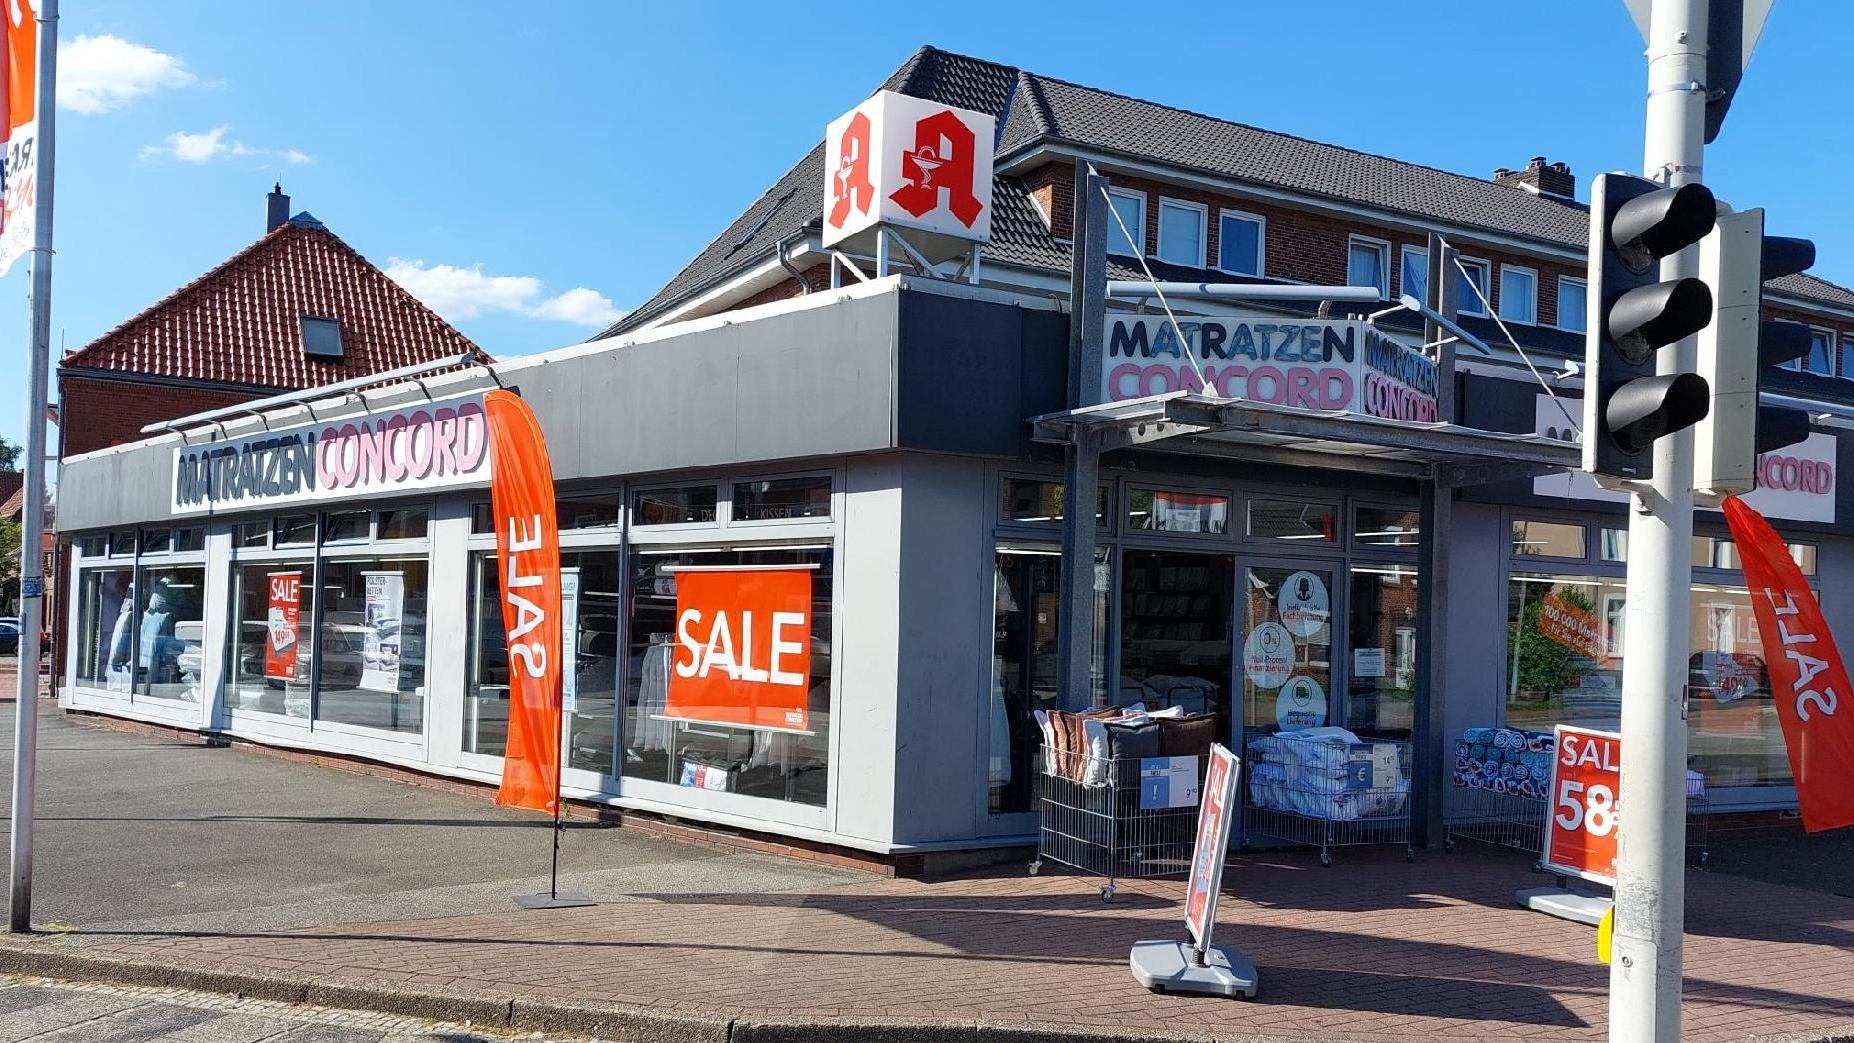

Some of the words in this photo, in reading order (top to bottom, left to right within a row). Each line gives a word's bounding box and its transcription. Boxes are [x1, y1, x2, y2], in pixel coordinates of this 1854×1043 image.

[1109, 320, 1355, 363] MATRATZEN
[1108, 363, 1354, 410] CONCORD
[176, 431, 316, 508] MATRATZEN
[316, 402, 488, 490] CONCORD
[1757, 453, 1833, 494] NCORD
[271, 578, 299, 603] SALE
[675, 609, 806, 686] SALE
[1561, 735, 1620, 772] SAL
